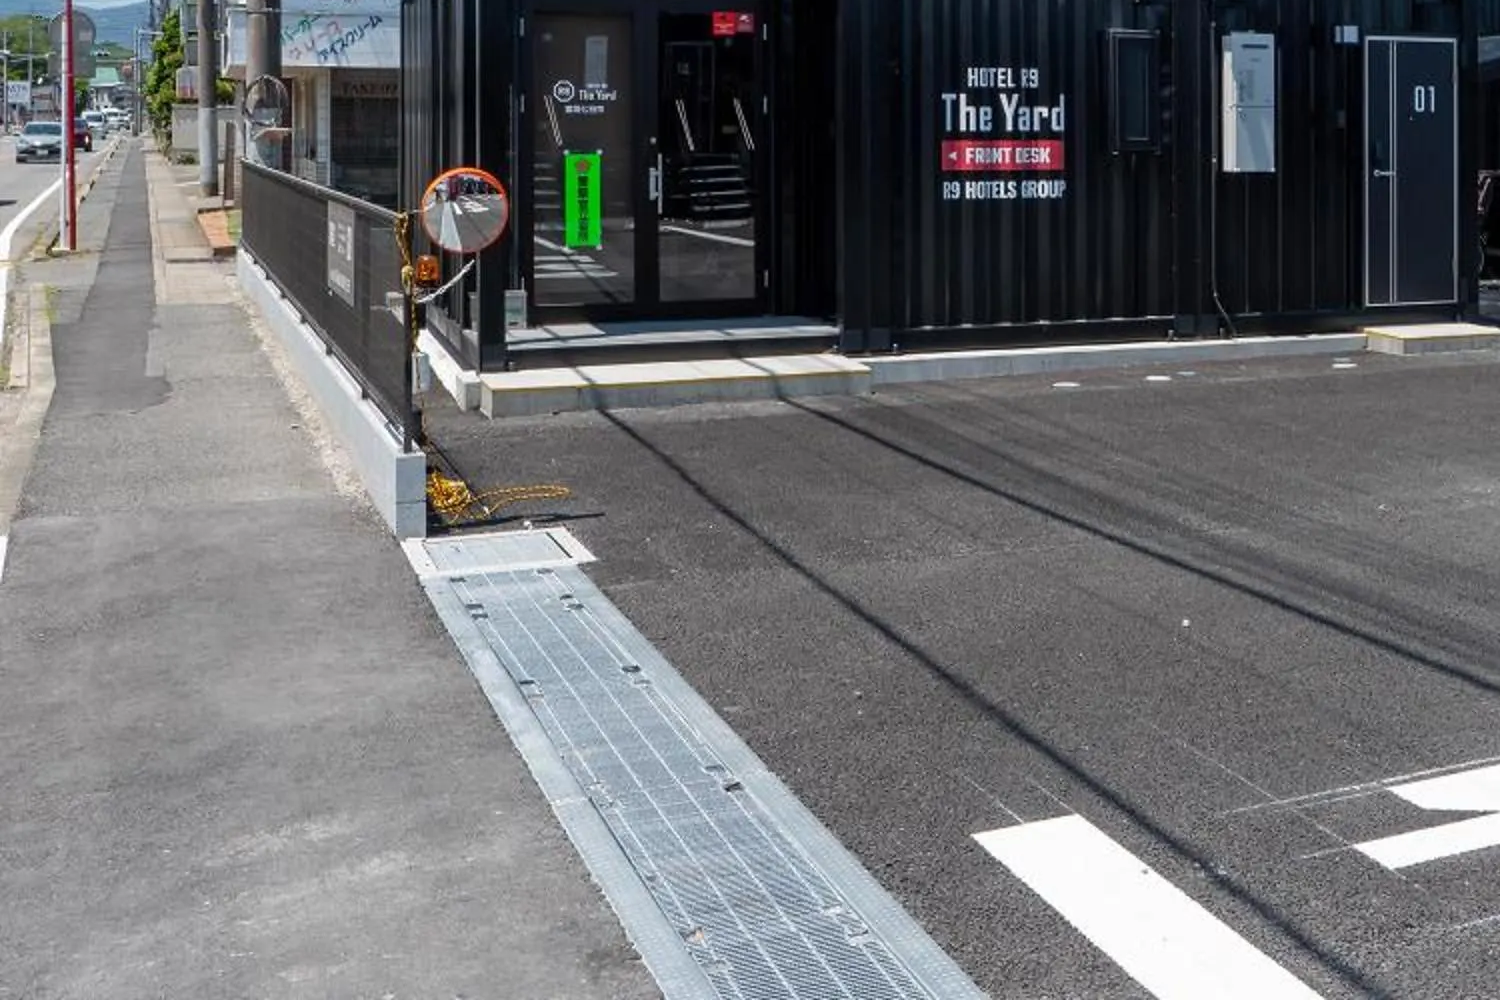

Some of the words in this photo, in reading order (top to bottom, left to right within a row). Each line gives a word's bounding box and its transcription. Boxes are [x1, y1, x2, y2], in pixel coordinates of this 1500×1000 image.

[967, 67, 1016, 87] HOTEL
[1021, 68, 1039, 88] R9
[1415, 85, 1435, 113] 01
[941, 93, 993, 132] The
[999, 93, 1065, 132] Yard
[965, 147, 1012, 164] FRONT
[1015, 147, 1051, 164] DESK
[943, 181, 960, 199] R9
[965, 181, 1017, 199] HOTELS
[1021, 179, 1067, 199] GROUP
